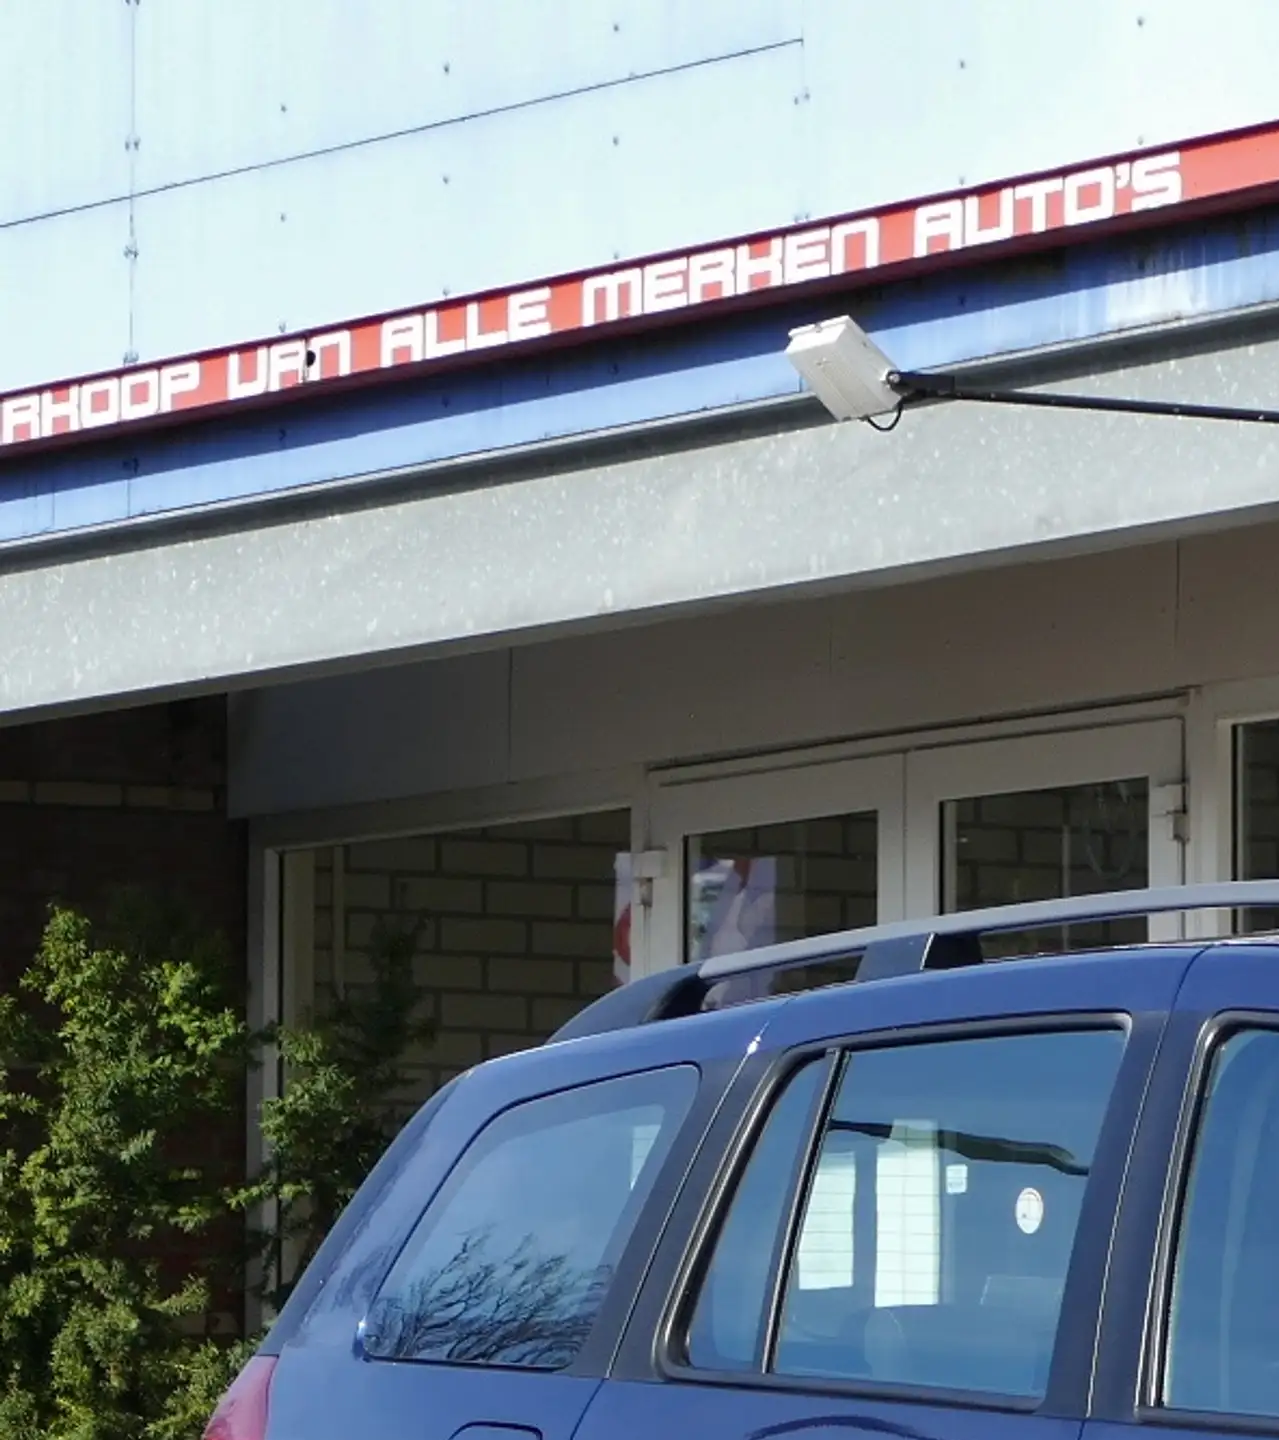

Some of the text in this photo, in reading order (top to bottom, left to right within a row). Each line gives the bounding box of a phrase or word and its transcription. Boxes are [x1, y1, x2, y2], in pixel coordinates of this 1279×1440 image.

[227, 329, 351, 400] VAN
[380, 286, 552, 368] ALLE
[581, 216, 880, 327] MERKEN
[913, 150, 1183, 258] AUTO'S
